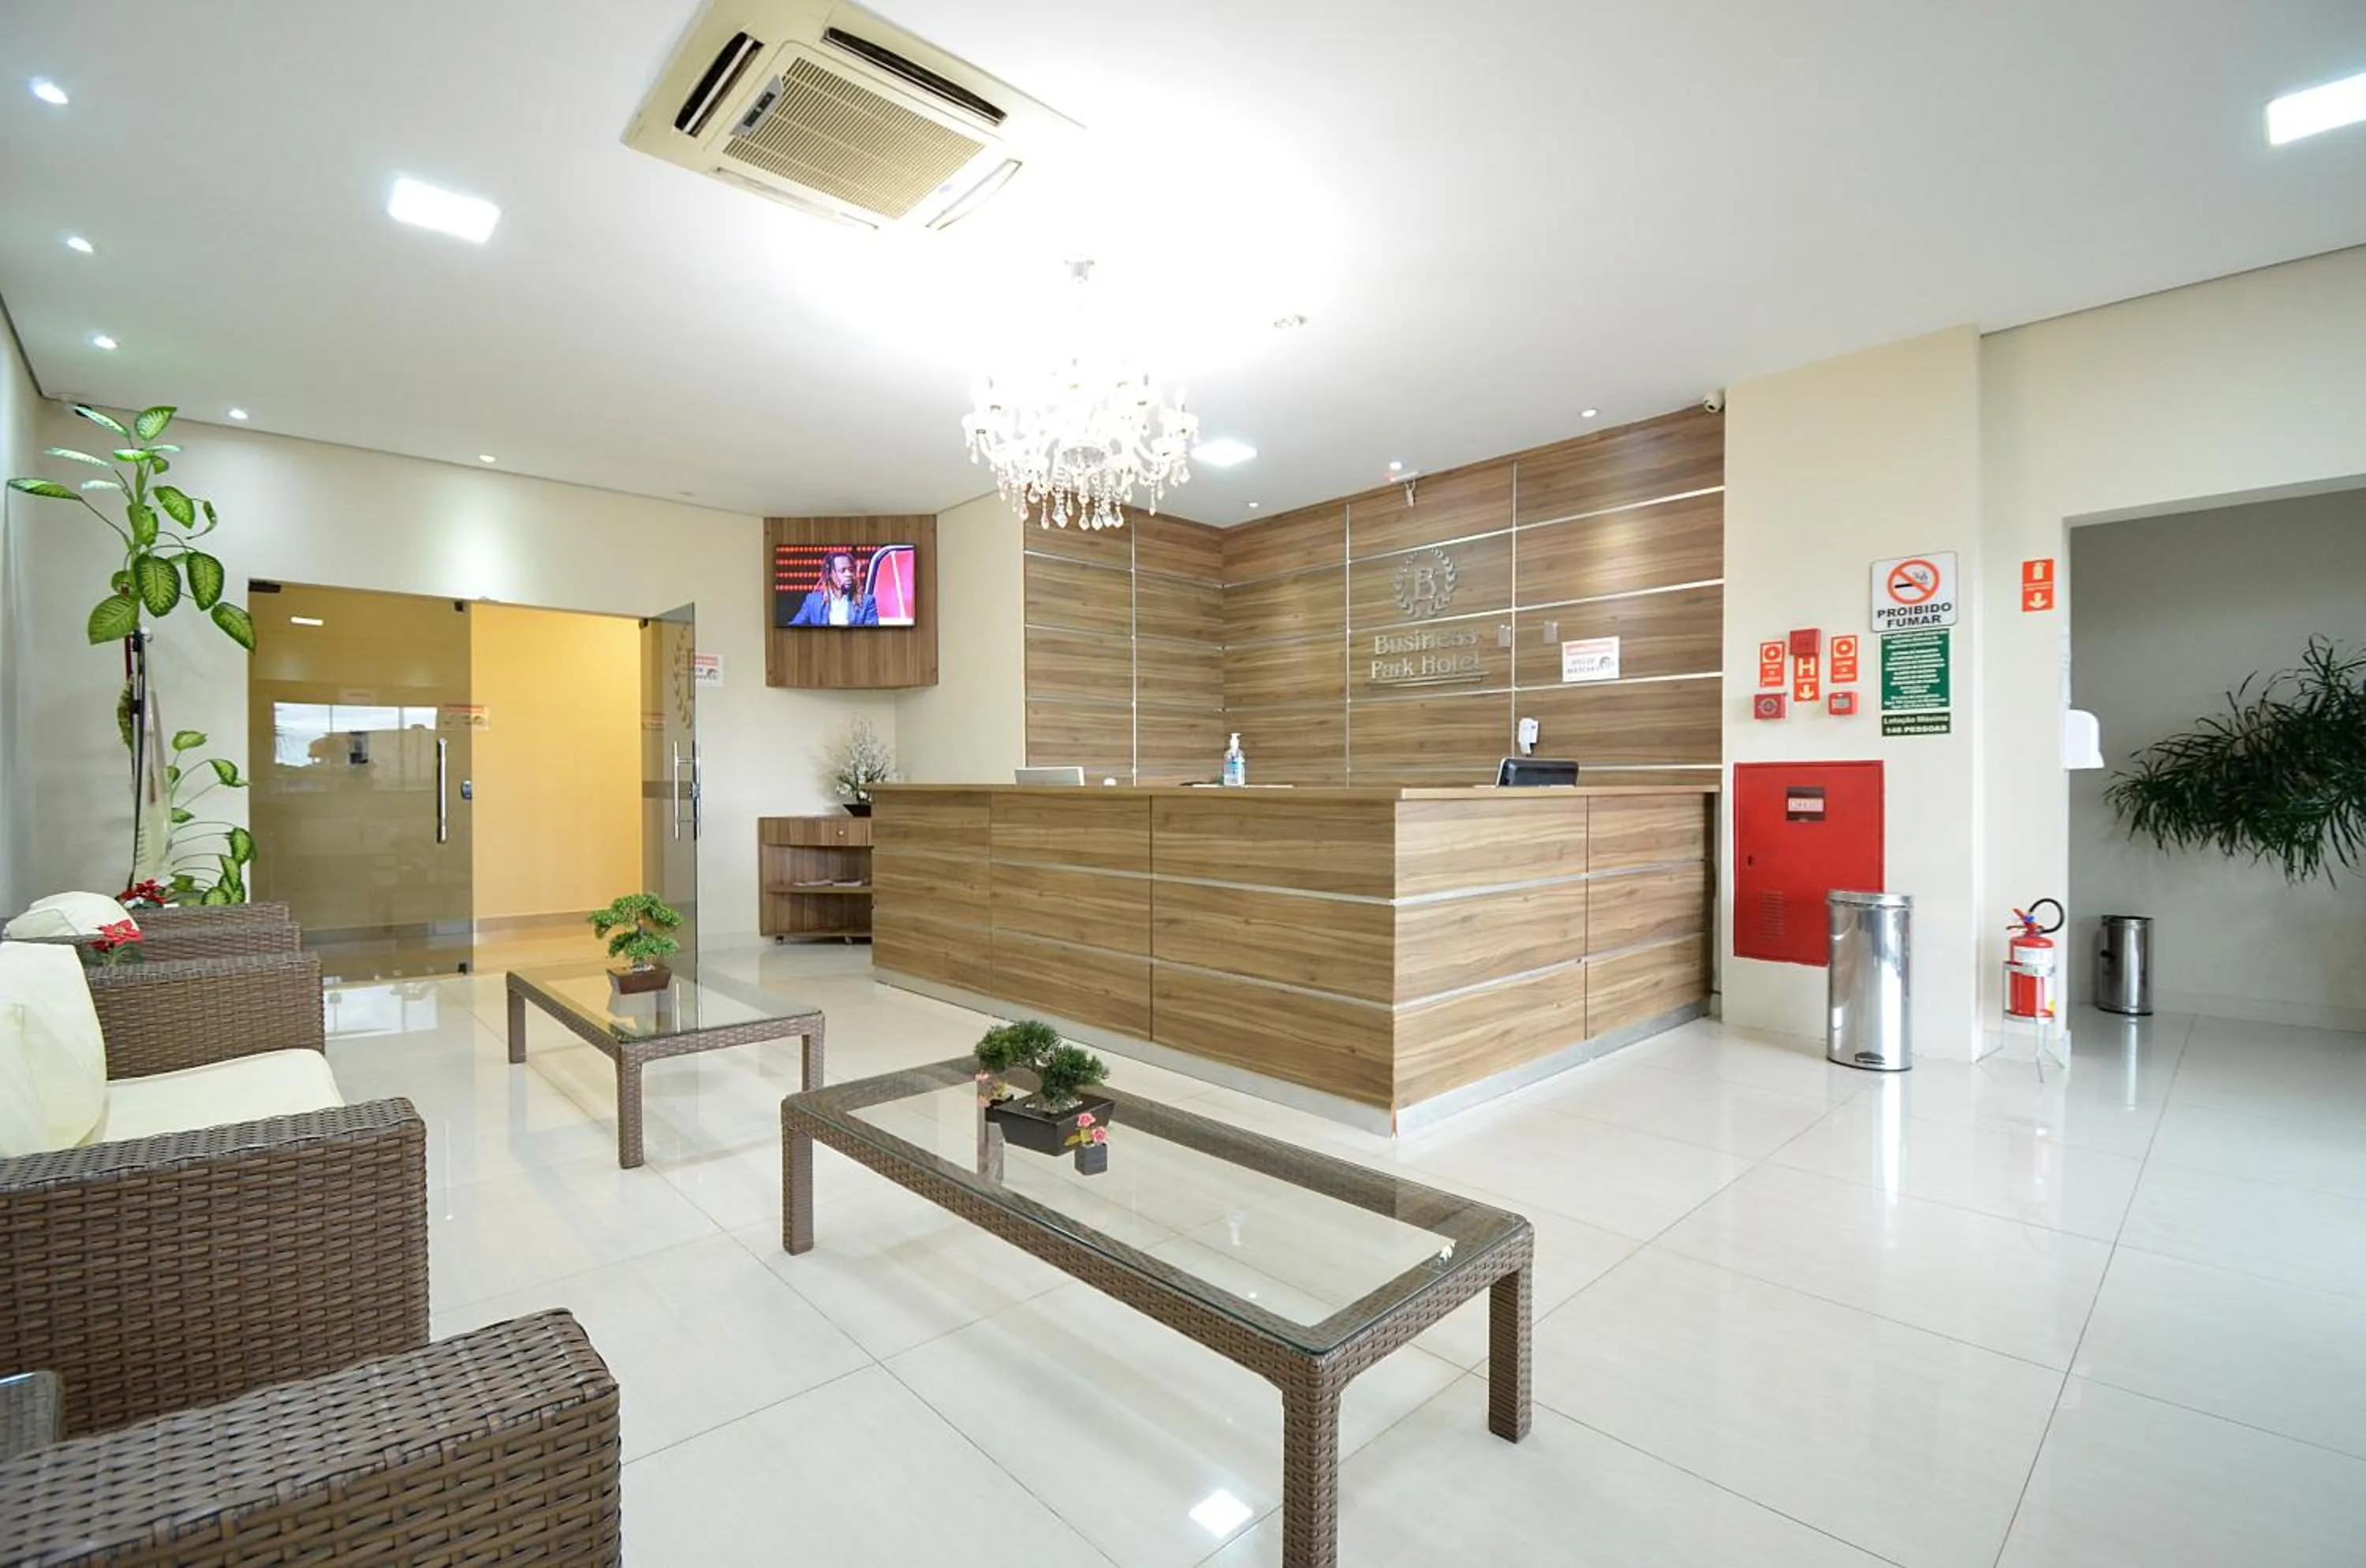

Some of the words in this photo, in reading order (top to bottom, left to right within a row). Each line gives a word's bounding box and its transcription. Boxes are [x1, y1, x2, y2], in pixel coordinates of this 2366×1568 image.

[1877, 602, 1952, 618] PROIBIDO
[1887, 614, 1942, 628] FUMAR
[1375, 629, 1479, 655] Business
[1371, 657, 1414, 679] Park
[1422, 651, 1480, 674] Hotel
